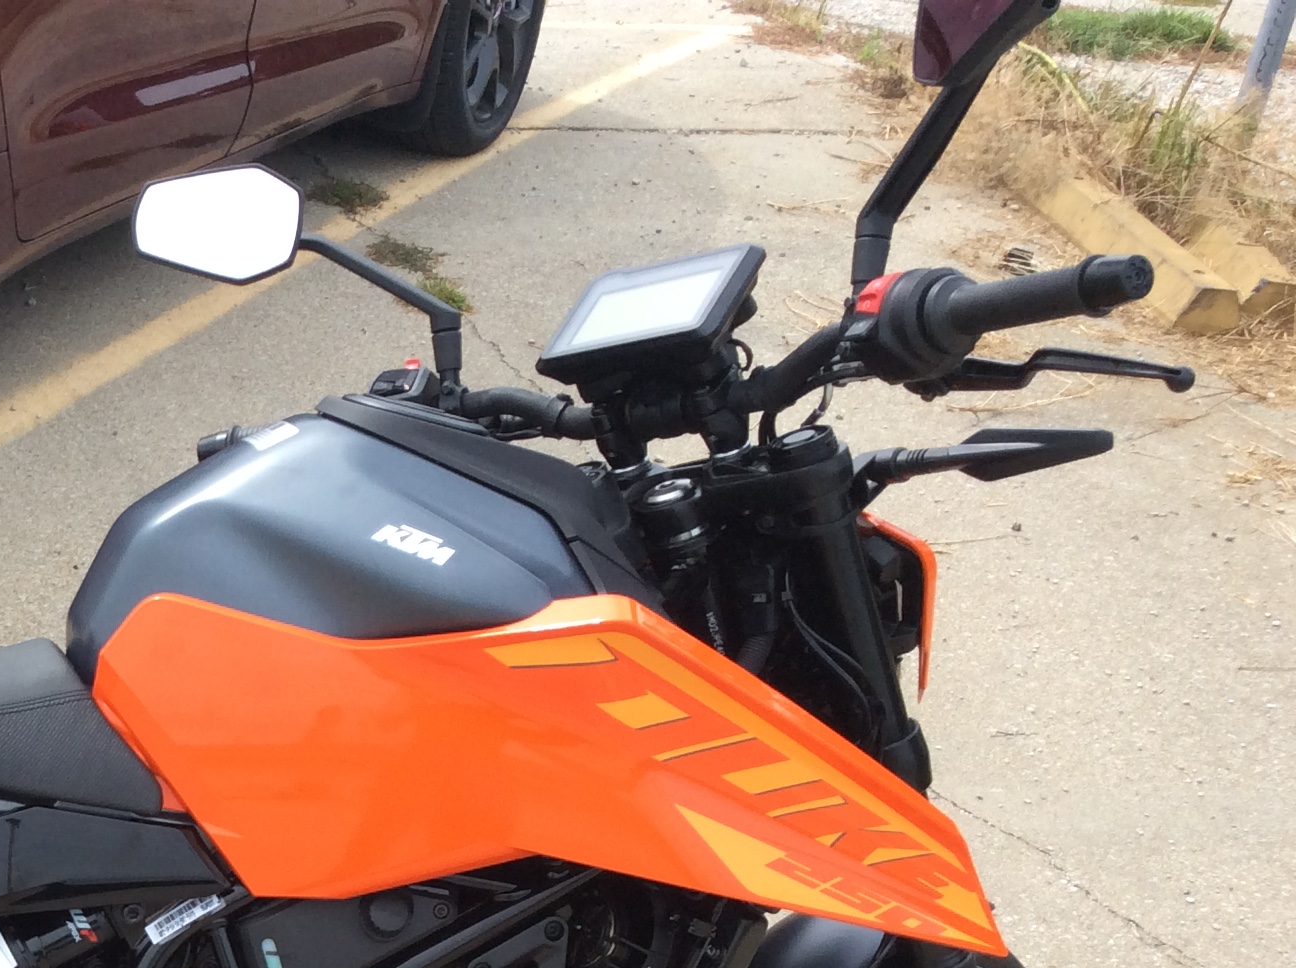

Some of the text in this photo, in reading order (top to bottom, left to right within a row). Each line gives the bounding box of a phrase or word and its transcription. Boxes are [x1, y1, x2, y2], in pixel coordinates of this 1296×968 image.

[370, 524, 456, 566] KTM
[764, 855, 948, 936] 250
[69, 908, 99, 943] WP
